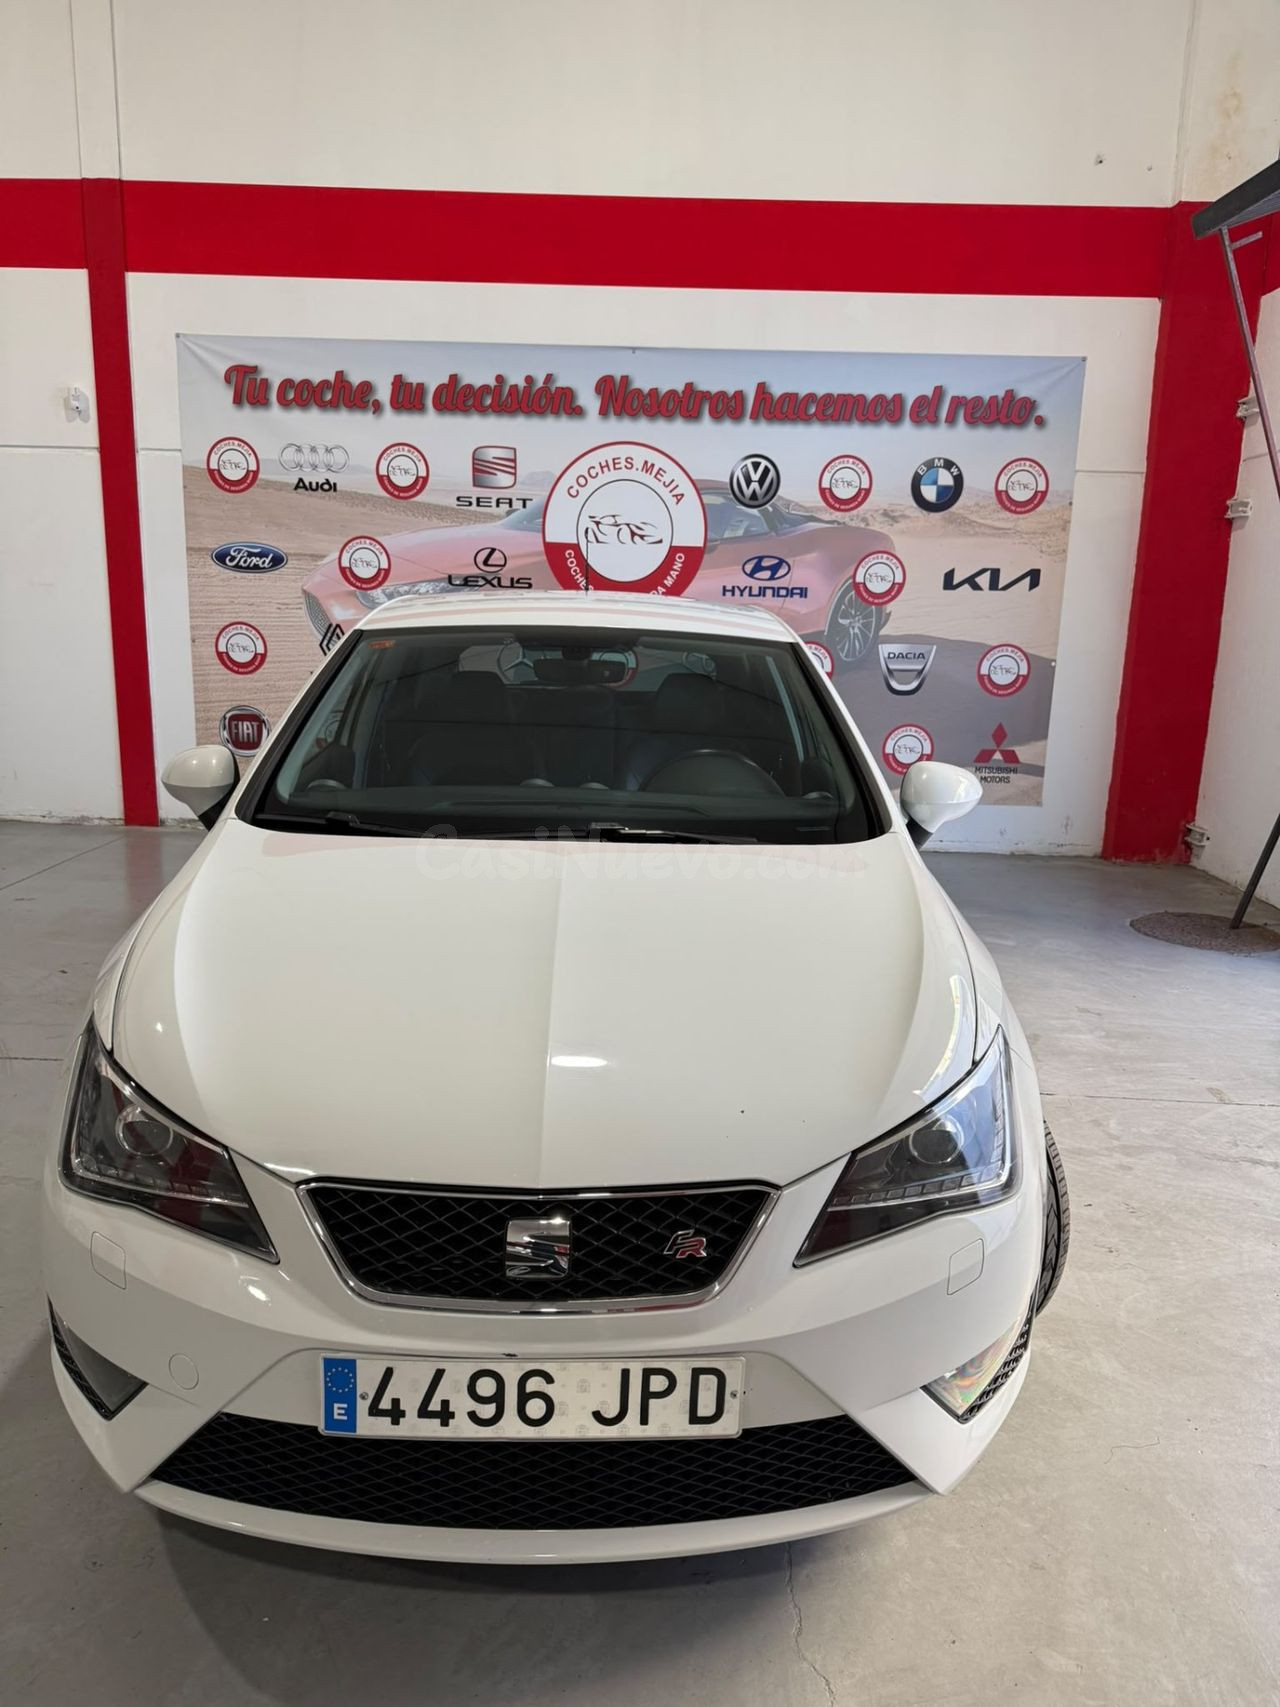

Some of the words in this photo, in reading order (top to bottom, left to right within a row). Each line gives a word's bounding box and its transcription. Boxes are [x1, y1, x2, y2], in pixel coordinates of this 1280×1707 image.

[224, 364, 270, 406] Tu
[276, 370, 383, 414] coche,
[389, 374, 425, 412] tu
[432, 373, 584, 417] decisión.
[595, 374, 744, 420] Nosotros
[750, 381, 902, 423] hacemos
[909, 385, 944, 424] el
[945, 389, 1044, 427] resto.
[294, 477, 338, 493] Audi
[566, 456, 686, 505] COCHES.MEJIA
[456, 495, 533, 509] SEAT
[224, 546, 273, 570] Ford
[663, 552, 686, 588] MANO
[942, 566, 1042, 592] KIA
[448, 573, 533, 590] LEXUS
[722, 584, 808, 599] HYUNDAI
[887, 651, 926, 662] DACIA
[231, 720, 260, 743] FIAT
[974, 765, 1018, 776] MITSUBISHI
[979, 774, 1011, 784] MOTORS
[367, 1366, 556, 1428] 4496
[591, 1366, 728, 1427] JPD
[333, 1403, 348, 1421] E
